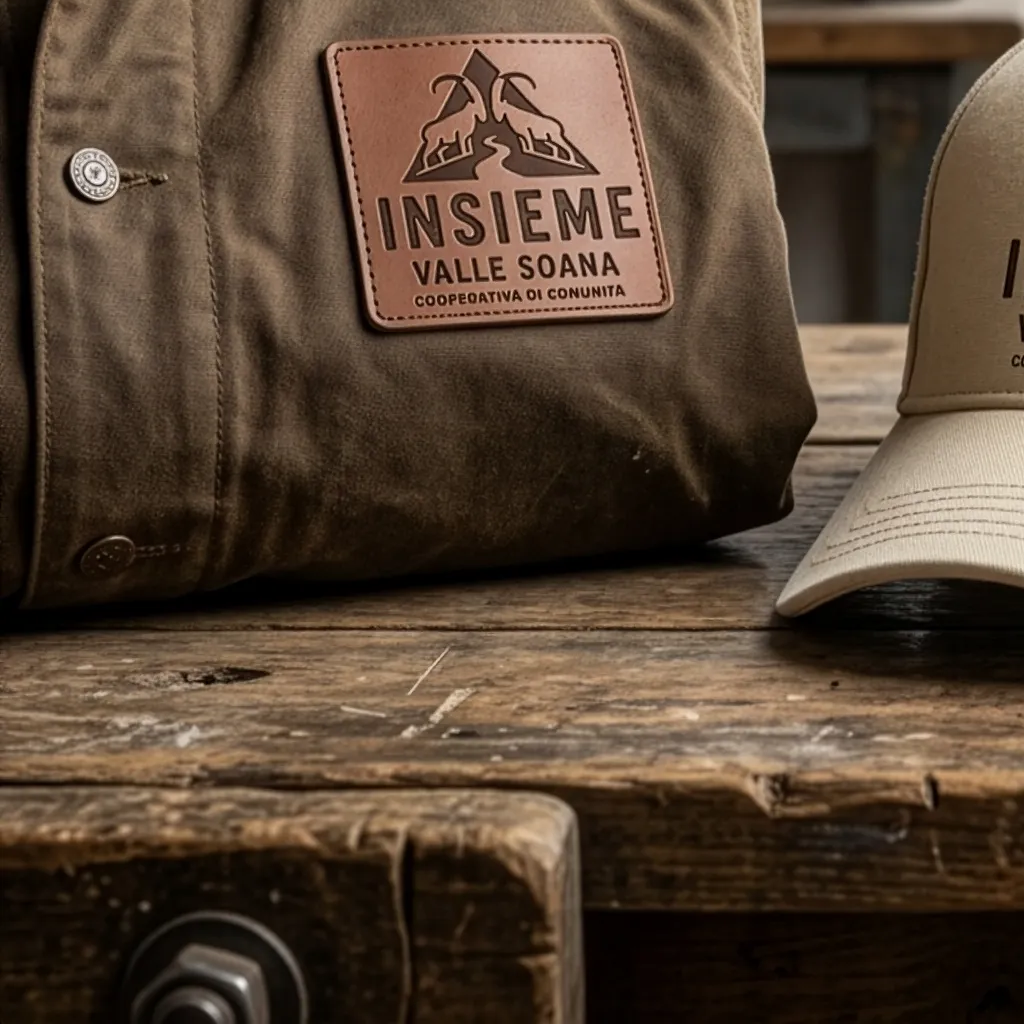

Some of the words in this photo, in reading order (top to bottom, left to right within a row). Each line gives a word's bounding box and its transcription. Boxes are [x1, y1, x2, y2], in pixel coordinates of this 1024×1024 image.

[378, 187, 641, 251] INSIEME
[412, 257, 507, 286] VALLE
[518, 252, 620, 280] SOANA
